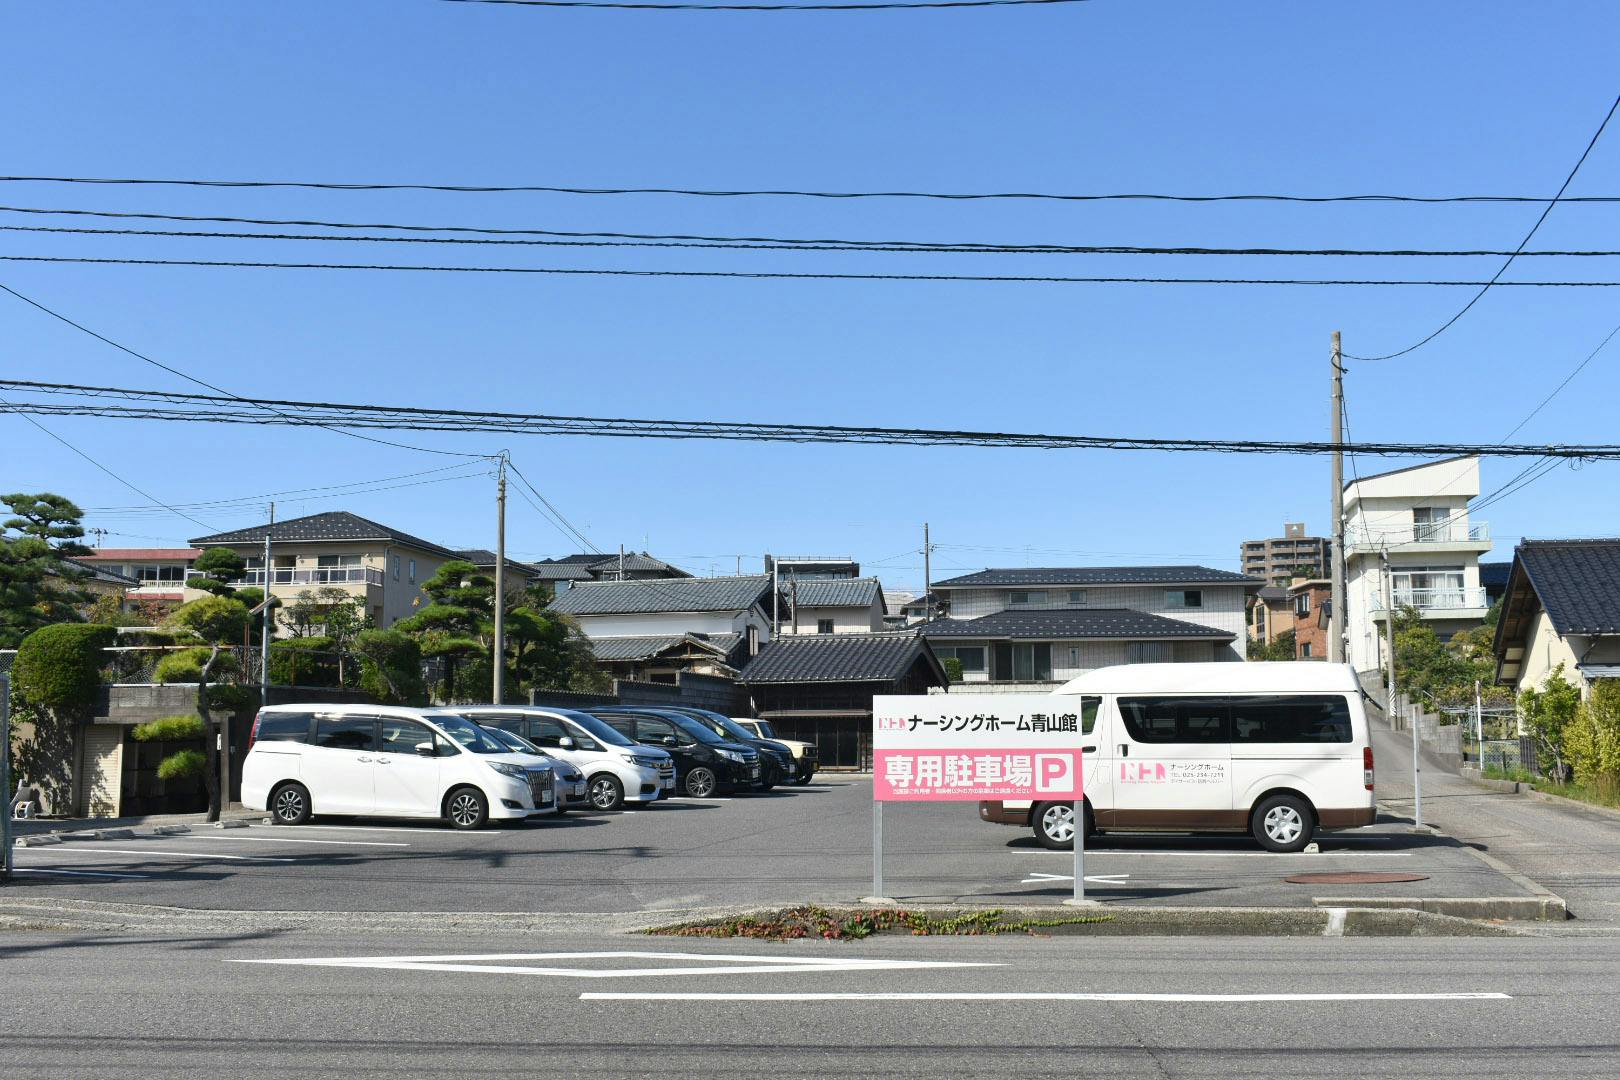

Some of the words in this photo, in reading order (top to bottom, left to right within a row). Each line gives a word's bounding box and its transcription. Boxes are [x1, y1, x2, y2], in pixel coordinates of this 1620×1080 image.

[908, 713, 1078, 733] ナーシングホーム青山館
[884, 754, 1032, 787] 専用駐車場
[1041, 757, 1067, 788] P
[1170, 763, 1224, 771] ナーシングホーム
